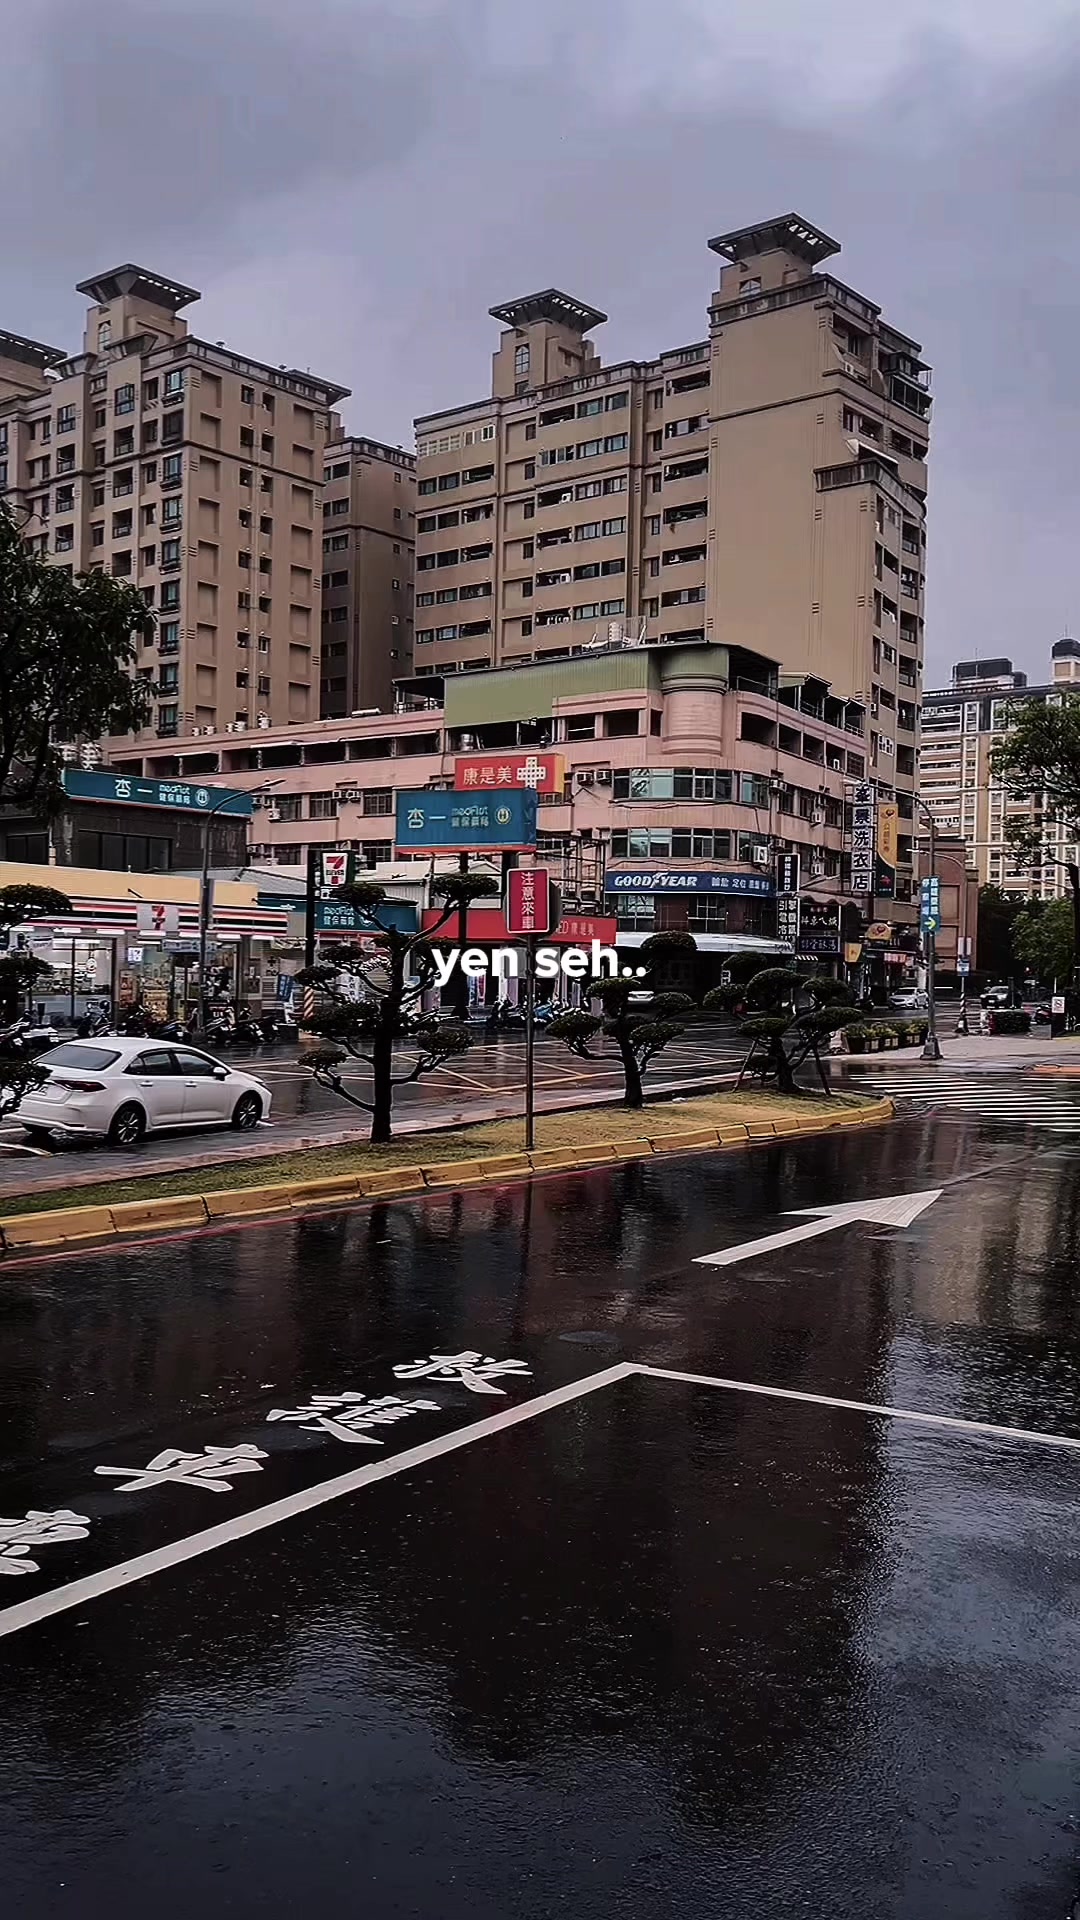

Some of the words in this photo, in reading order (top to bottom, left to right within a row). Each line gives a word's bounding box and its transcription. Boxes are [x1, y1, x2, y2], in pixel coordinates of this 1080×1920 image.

[463, 766, 512, 785] 康是美
[115, 779, 153, 798] 杏一
[407, 808, 446, 829] 杏一
[614, 872, 698, 889] GOODYEAR
[520, 871, 535, 930] 注意來車
